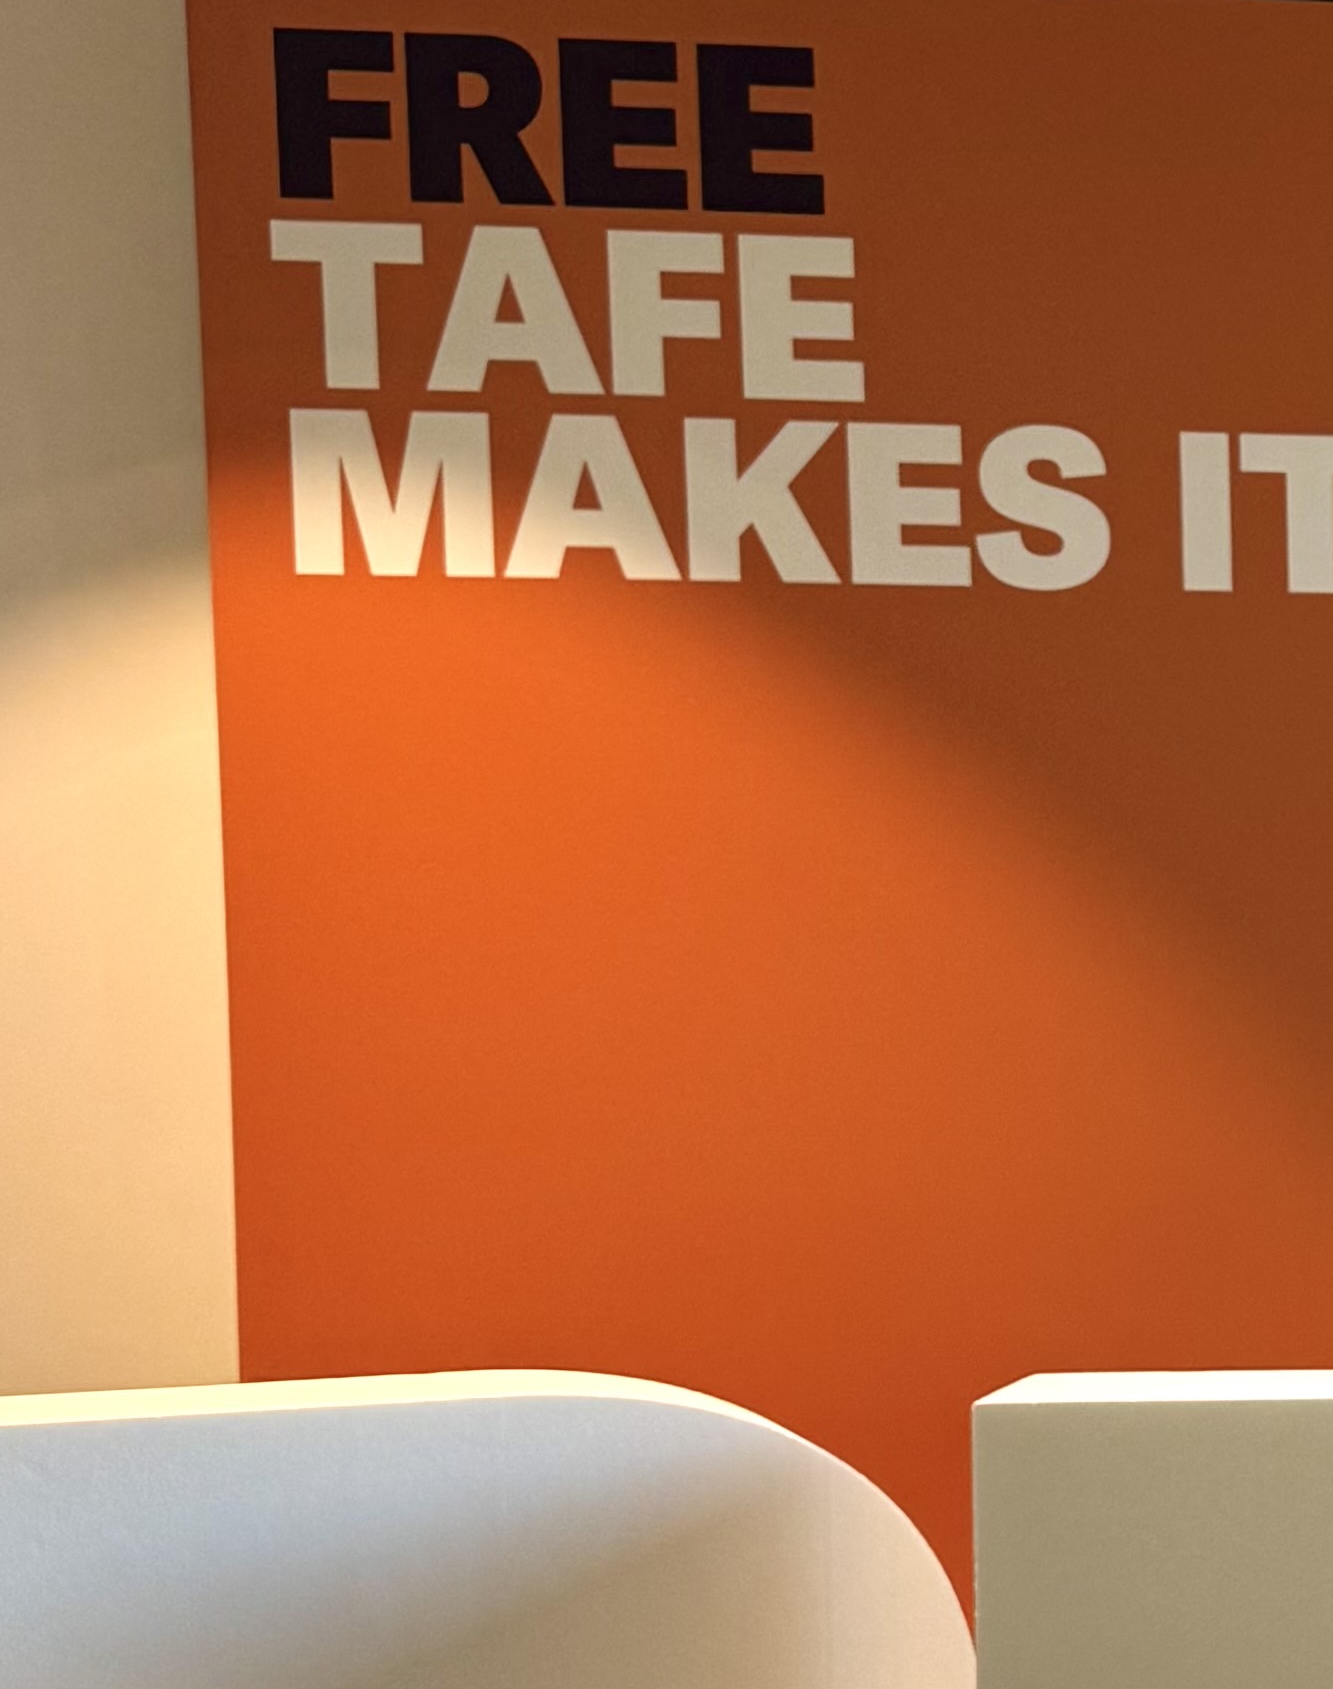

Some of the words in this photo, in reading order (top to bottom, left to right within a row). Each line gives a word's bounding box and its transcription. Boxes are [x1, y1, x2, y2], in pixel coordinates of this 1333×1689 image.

[272, 27, 825, 216] FREE
[269, 218, 866, 403] TAFE
[289, 407, 1112, 592] MAKES
